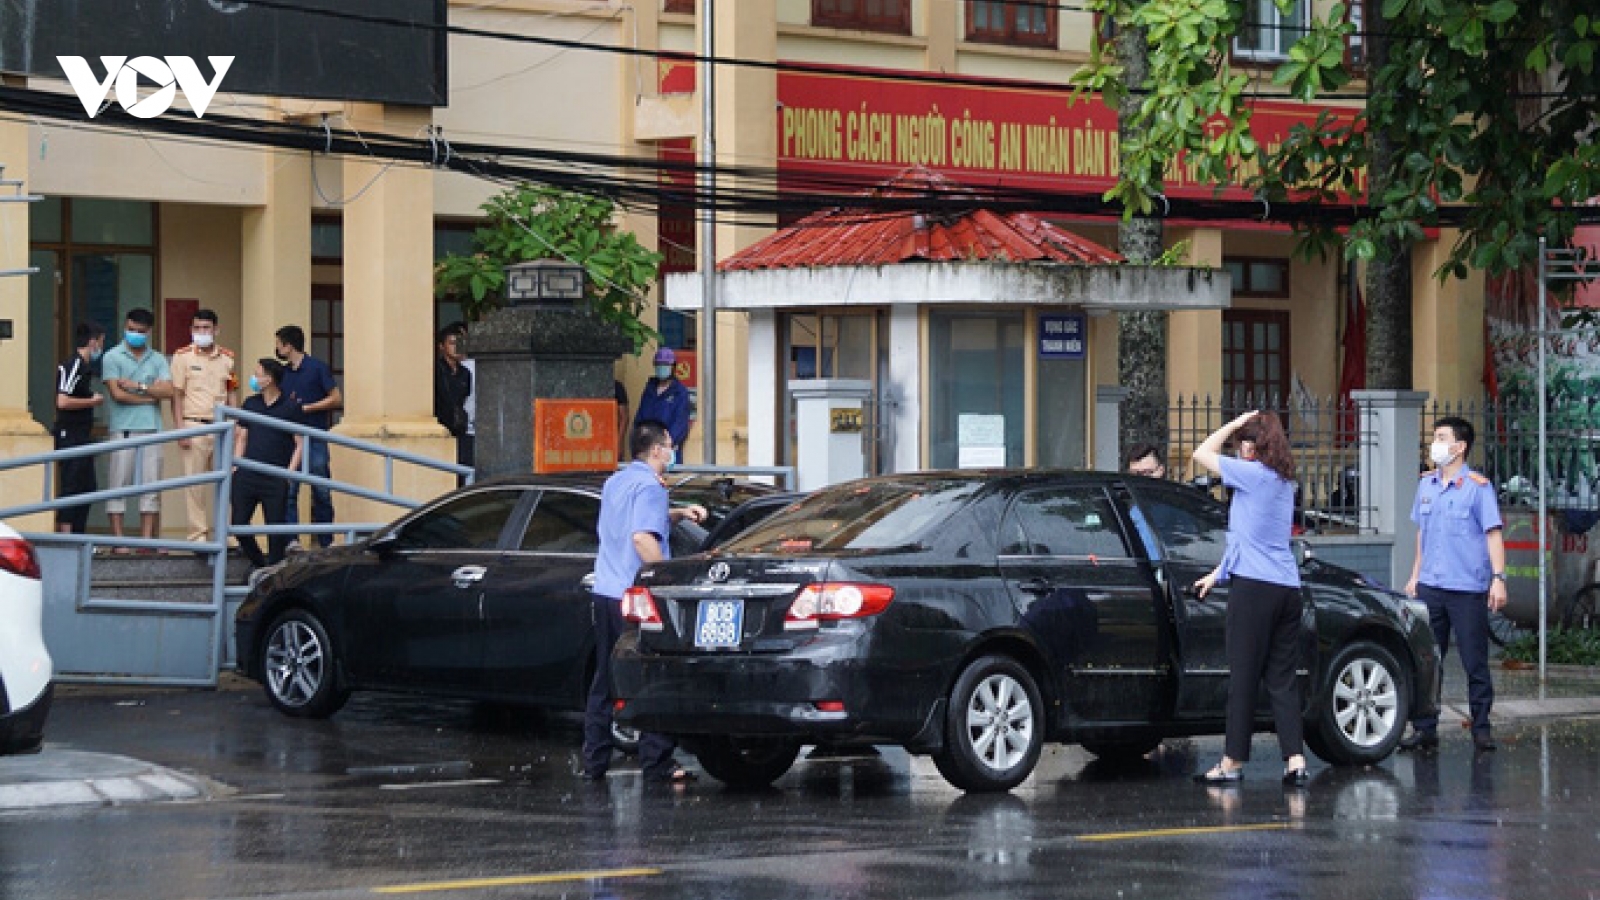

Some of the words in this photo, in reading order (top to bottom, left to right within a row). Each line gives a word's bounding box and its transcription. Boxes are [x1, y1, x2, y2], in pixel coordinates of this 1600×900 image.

[783, 106, 843, 160] PHONG
[847, 101, 892, 163] CÁCH
[896, 103, 947, 167] NGƯỜI
[951, 109, 995, 169] CÔNG
[999, 121, 1022, 171] AN
[1026, 115, 1070, 174] NHÂN
[1073, 118, 1105, 177] DÂN
